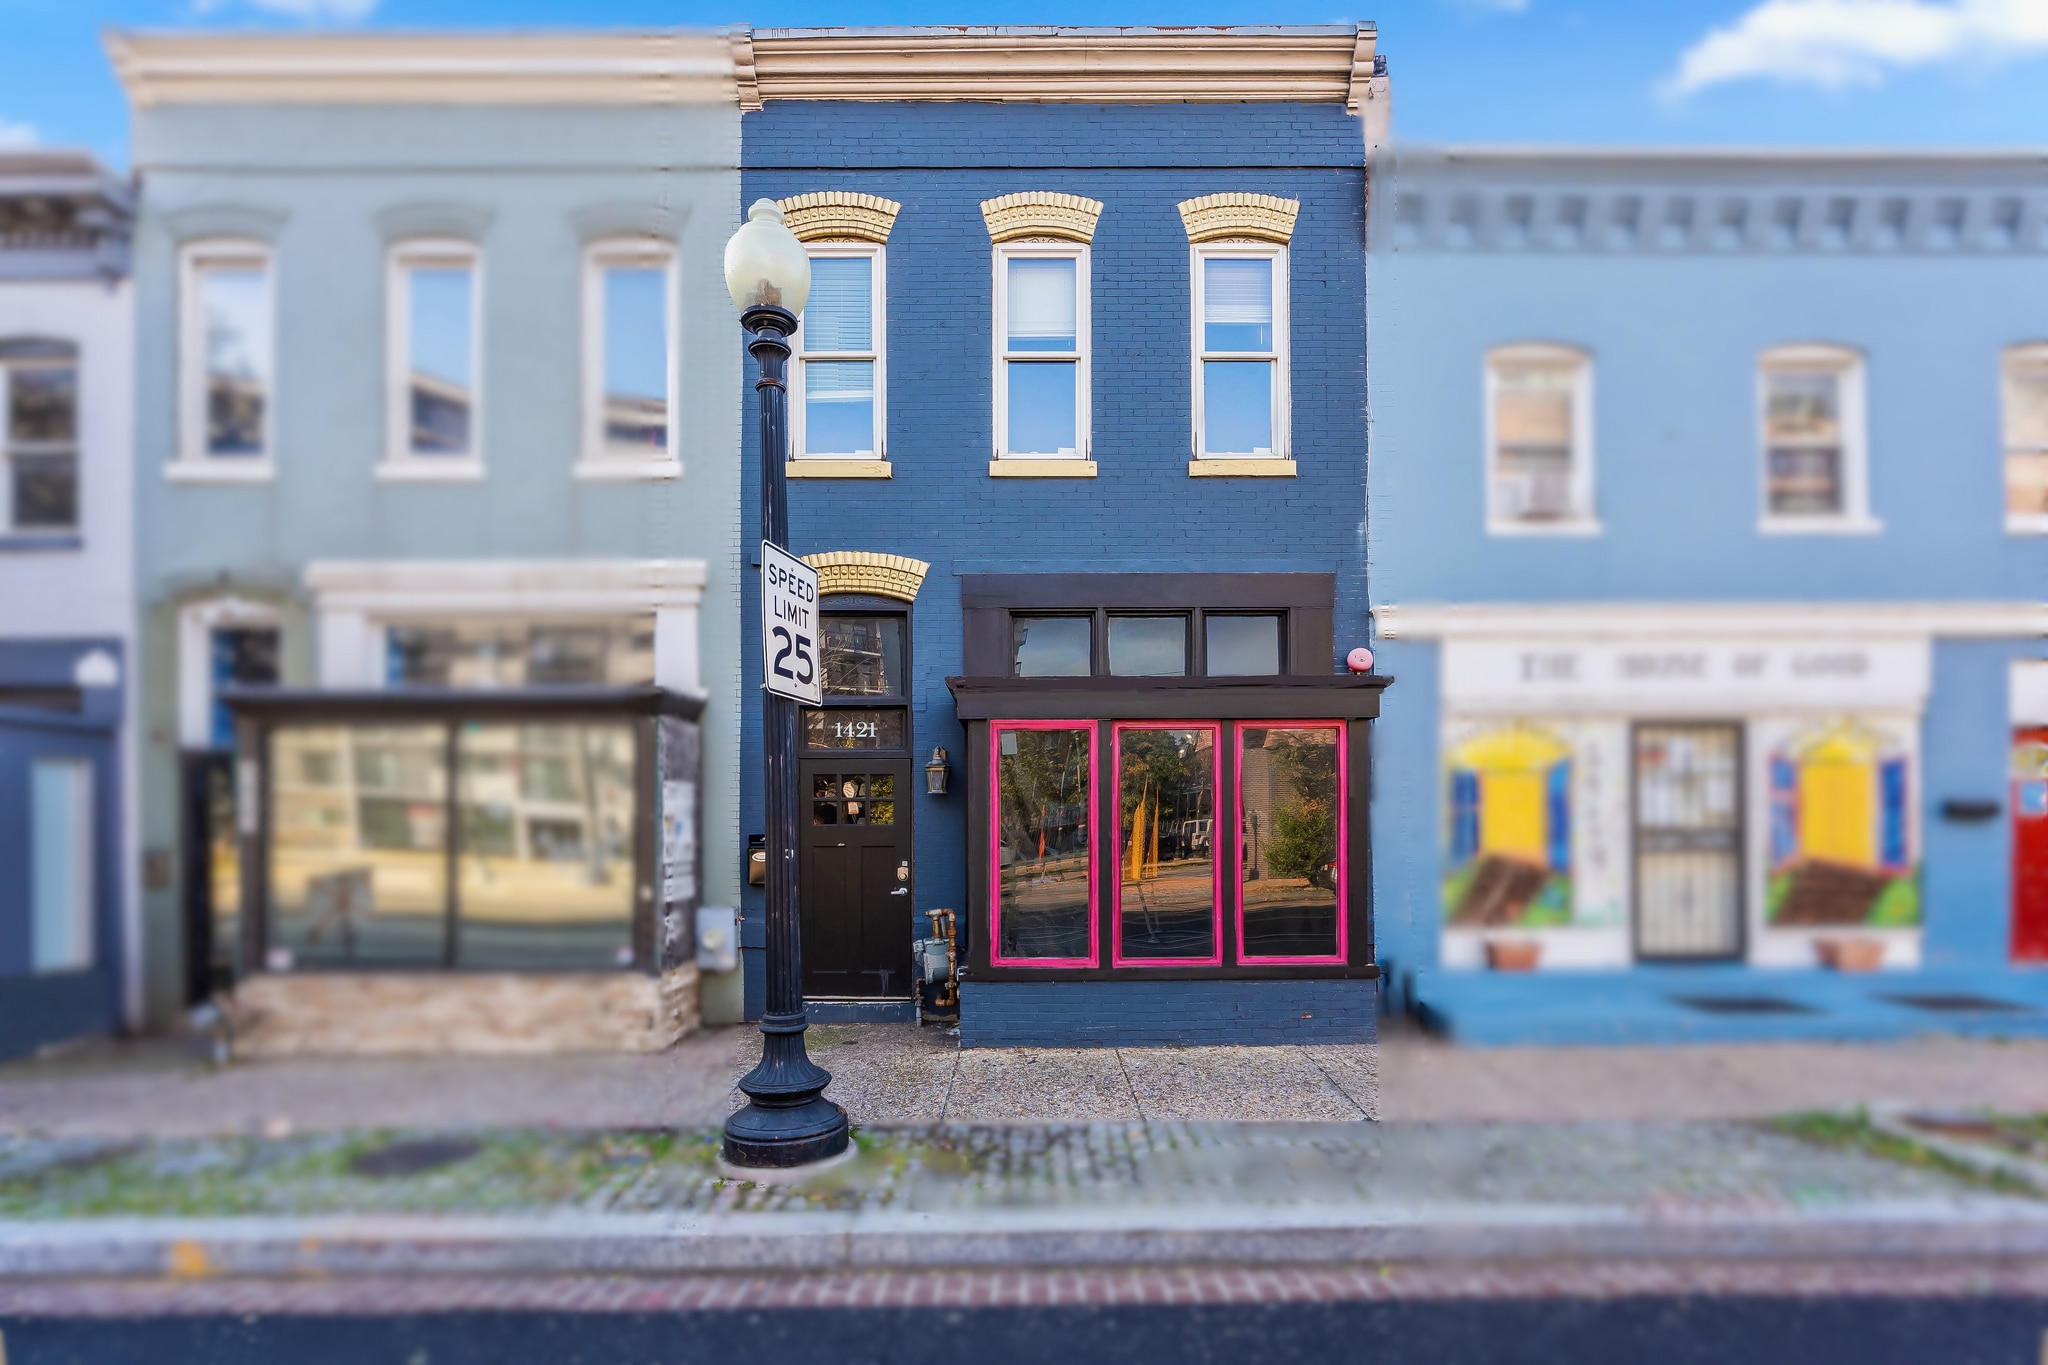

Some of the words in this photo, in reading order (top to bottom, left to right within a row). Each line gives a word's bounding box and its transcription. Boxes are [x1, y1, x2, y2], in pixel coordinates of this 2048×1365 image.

[769, 563, 814, 603] SPEED
[774, 595, 810, 629] LIMIT
[772, 626, 814, 685] 25
[834, 721, 877, 738] 1421
